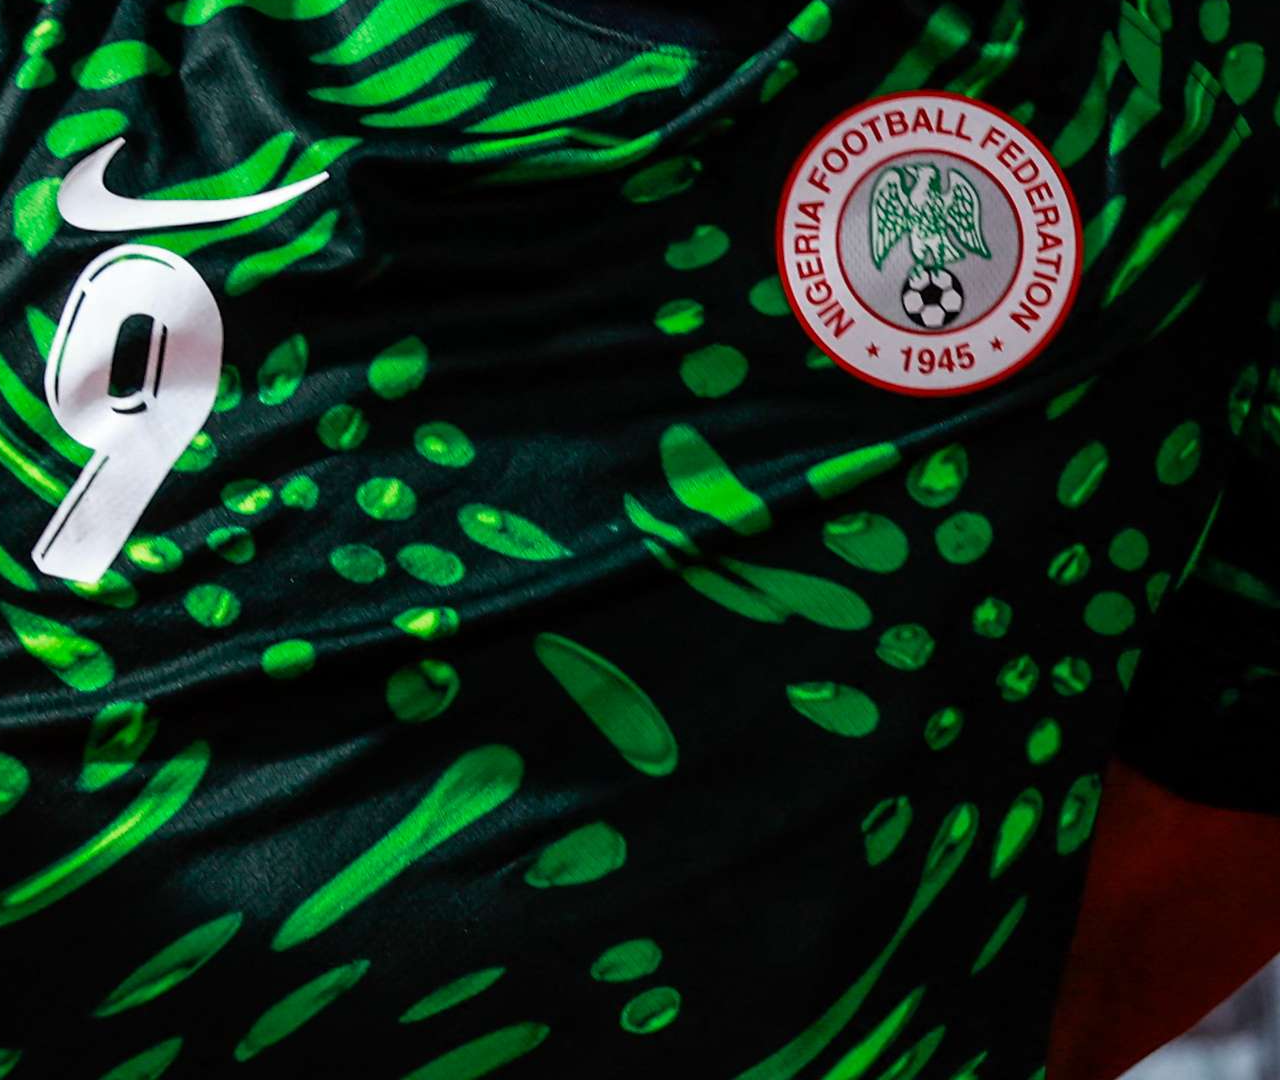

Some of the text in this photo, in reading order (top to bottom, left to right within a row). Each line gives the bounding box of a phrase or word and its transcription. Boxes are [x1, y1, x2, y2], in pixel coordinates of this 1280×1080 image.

[794, 106, 1064, 339] NIGERIA FOOTBALL FEDERATION
[32, 243, 224, 583] 9
[900, 342, 976, 375] 1945
